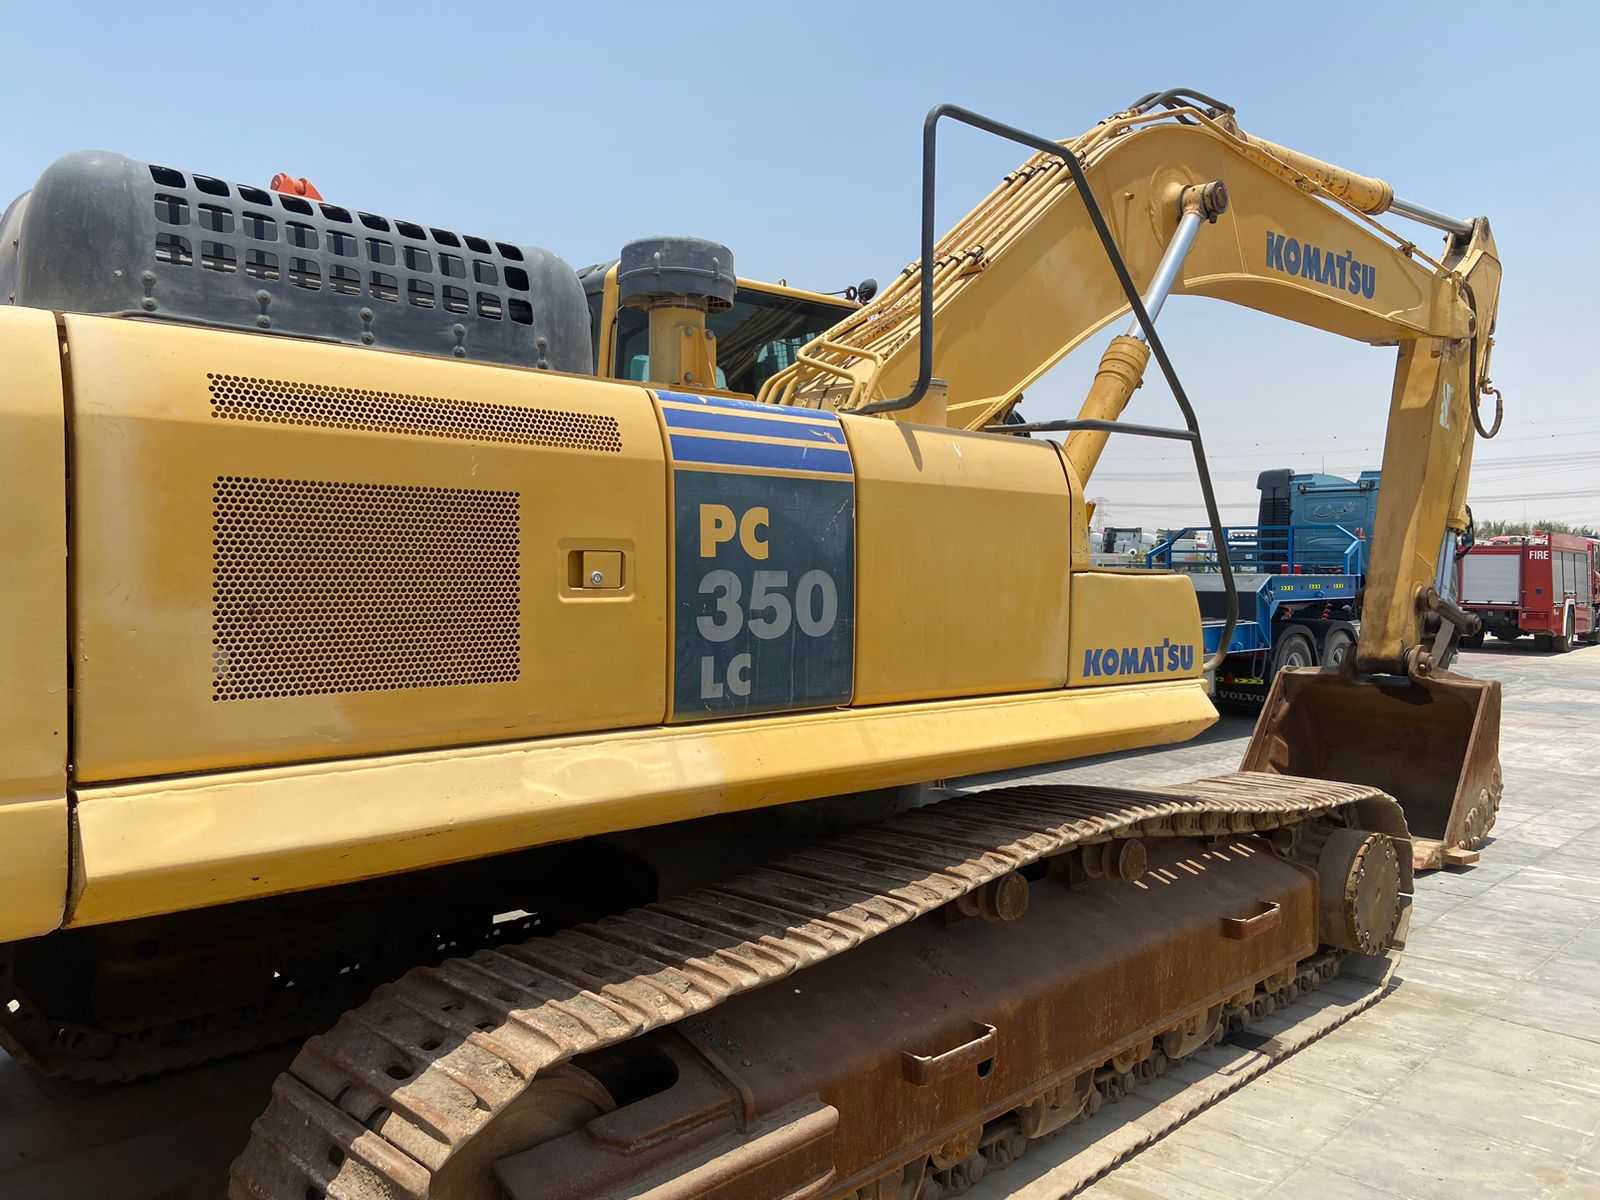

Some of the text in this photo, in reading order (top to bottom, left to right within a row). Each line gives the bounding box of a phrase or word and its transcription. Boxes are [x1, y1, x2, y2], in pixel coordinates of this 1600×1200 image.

[1265, 230, 1376, 299] KOMATSU
[700, 503, 769, 560] PC
[1529, 550, 1549, 560] FIRE
[696, 569, 838, 642] 350
[700, 653, 751, 699] LC
[1082, 637, 1194, 677] KOMATSU
[1220, 690, 1265, 702] VOLVO
